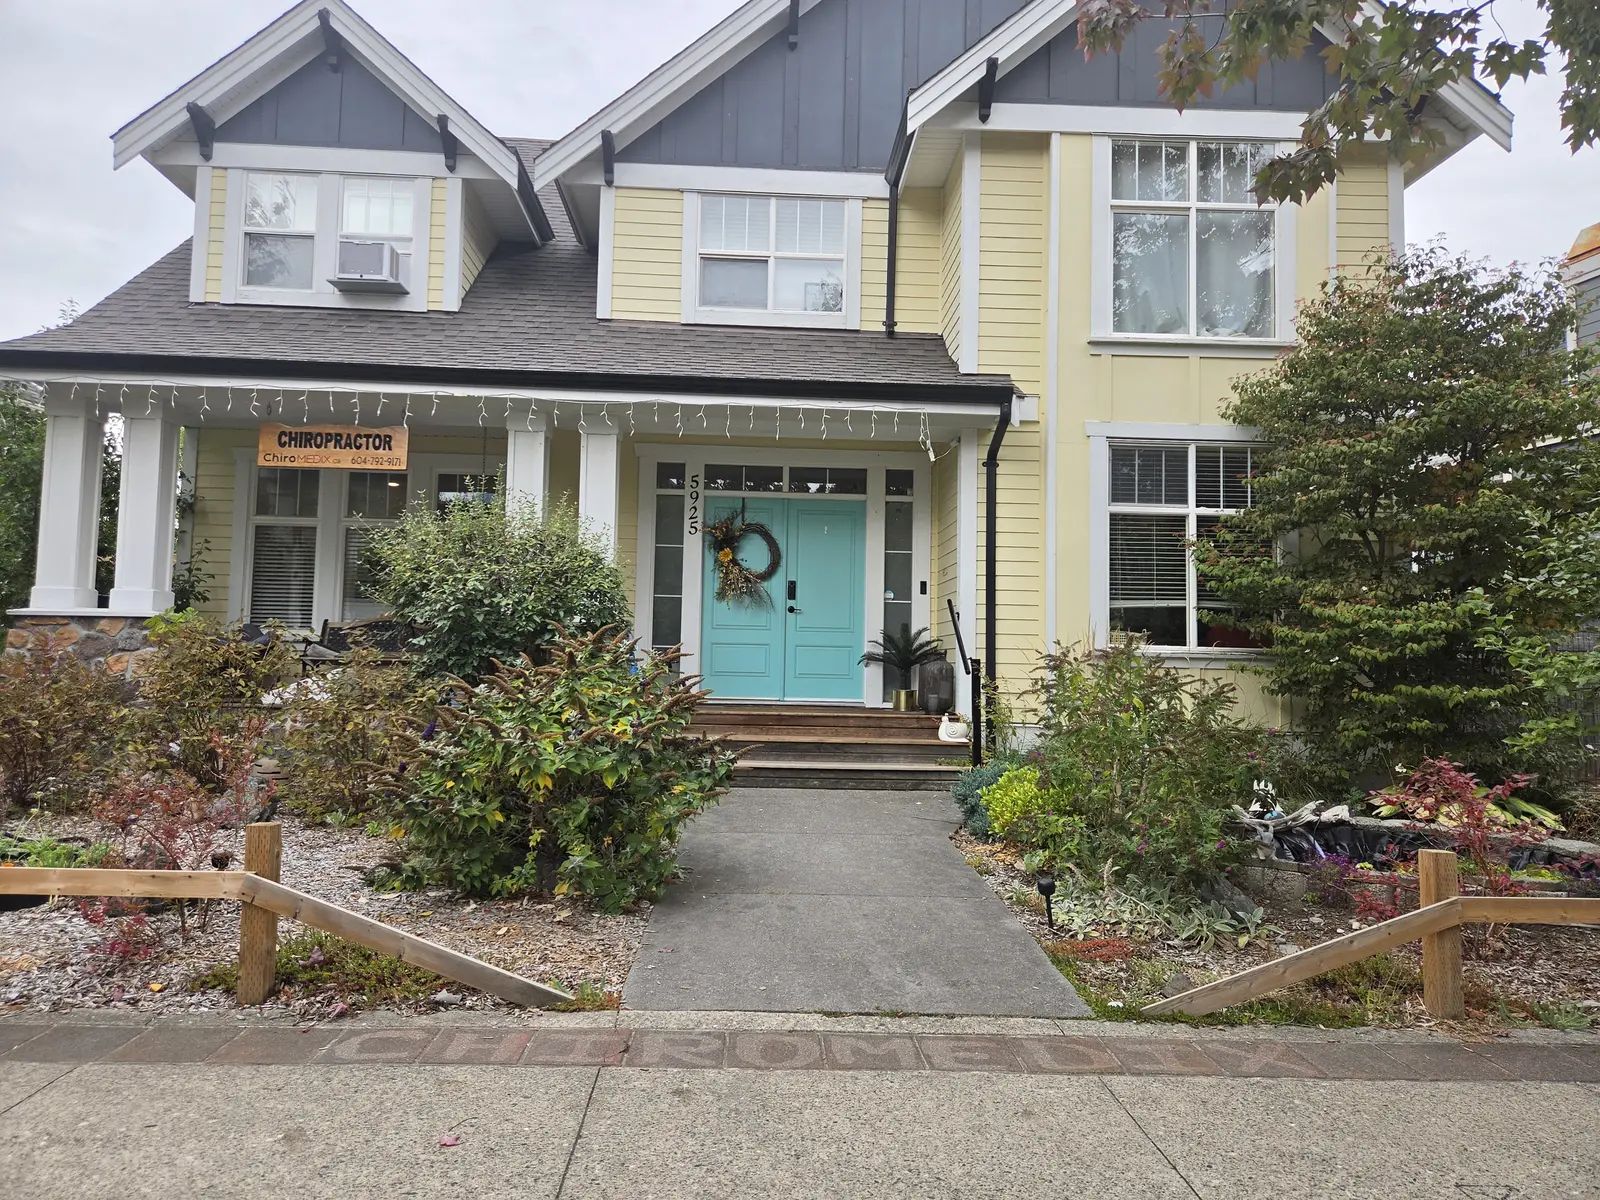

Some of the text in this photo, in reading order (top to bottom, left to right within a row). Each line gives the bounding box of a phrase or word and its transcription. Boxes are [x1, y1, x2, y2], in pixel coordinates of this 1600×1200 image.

[278, 430, 393, 451] CHIROPRACTOR
[350, 456, 402, 467] 604-792-9171
[688, 474, 700, 535] 5925
